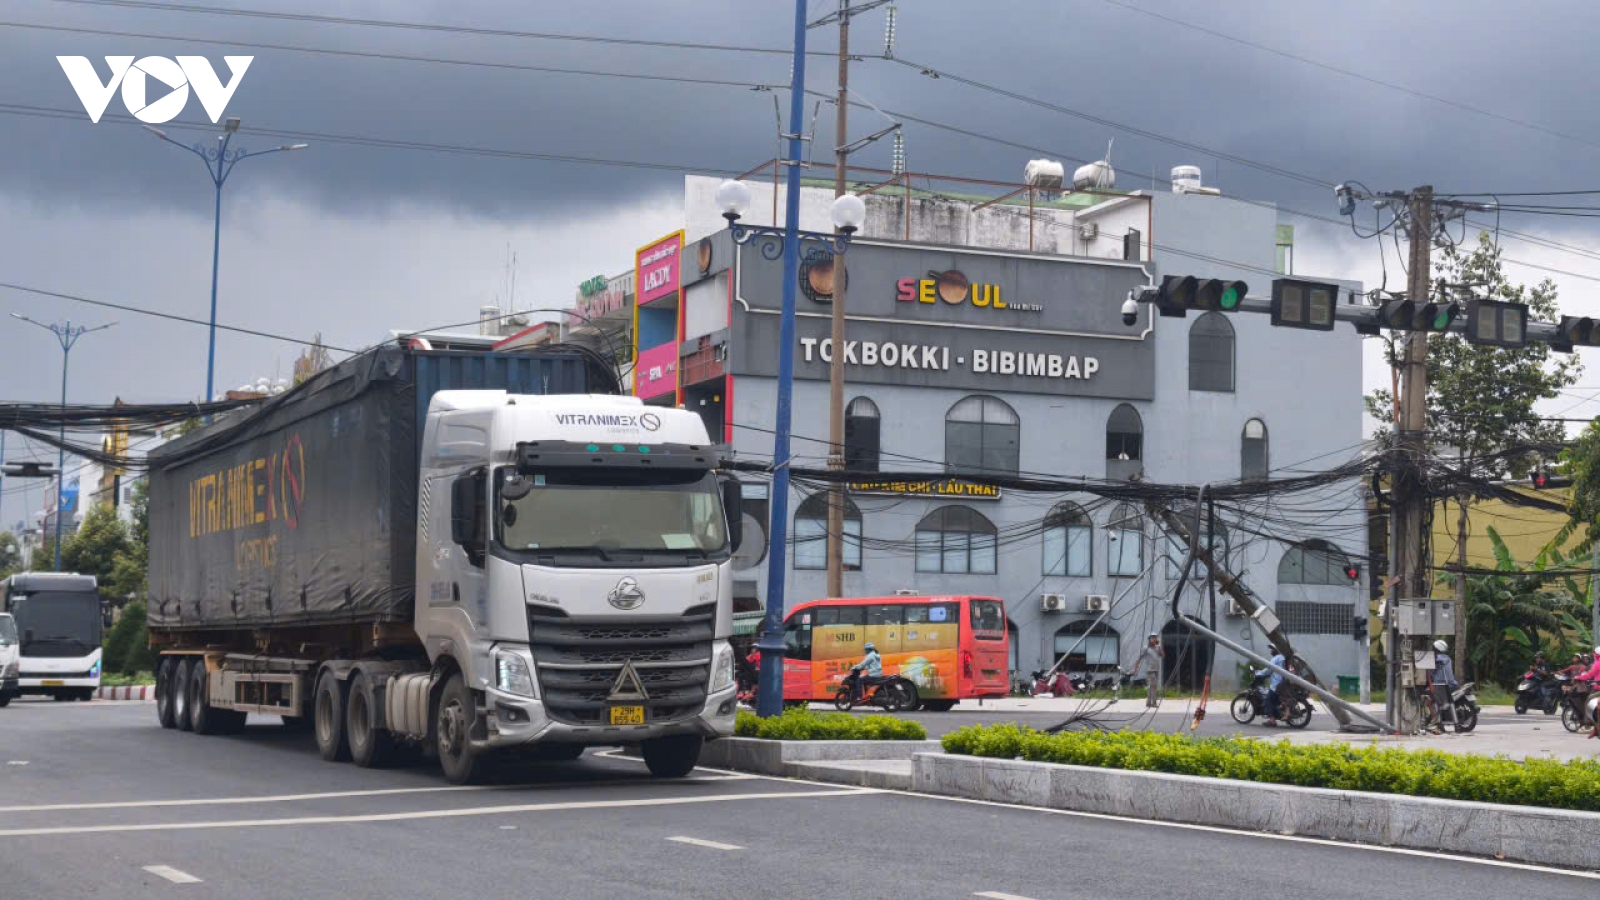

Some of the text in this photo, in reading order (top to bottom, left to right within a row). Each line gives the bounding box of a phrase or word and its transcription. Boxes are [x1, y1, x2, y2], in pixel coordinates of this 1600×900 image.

[800, 337, 950, 371] TOKBOKKI
[973, 349, 1100, 380] BIBIMBAP
[555, 414, 638, 427] VITRANIMEX
[835, 632, 856, 642] SHB
